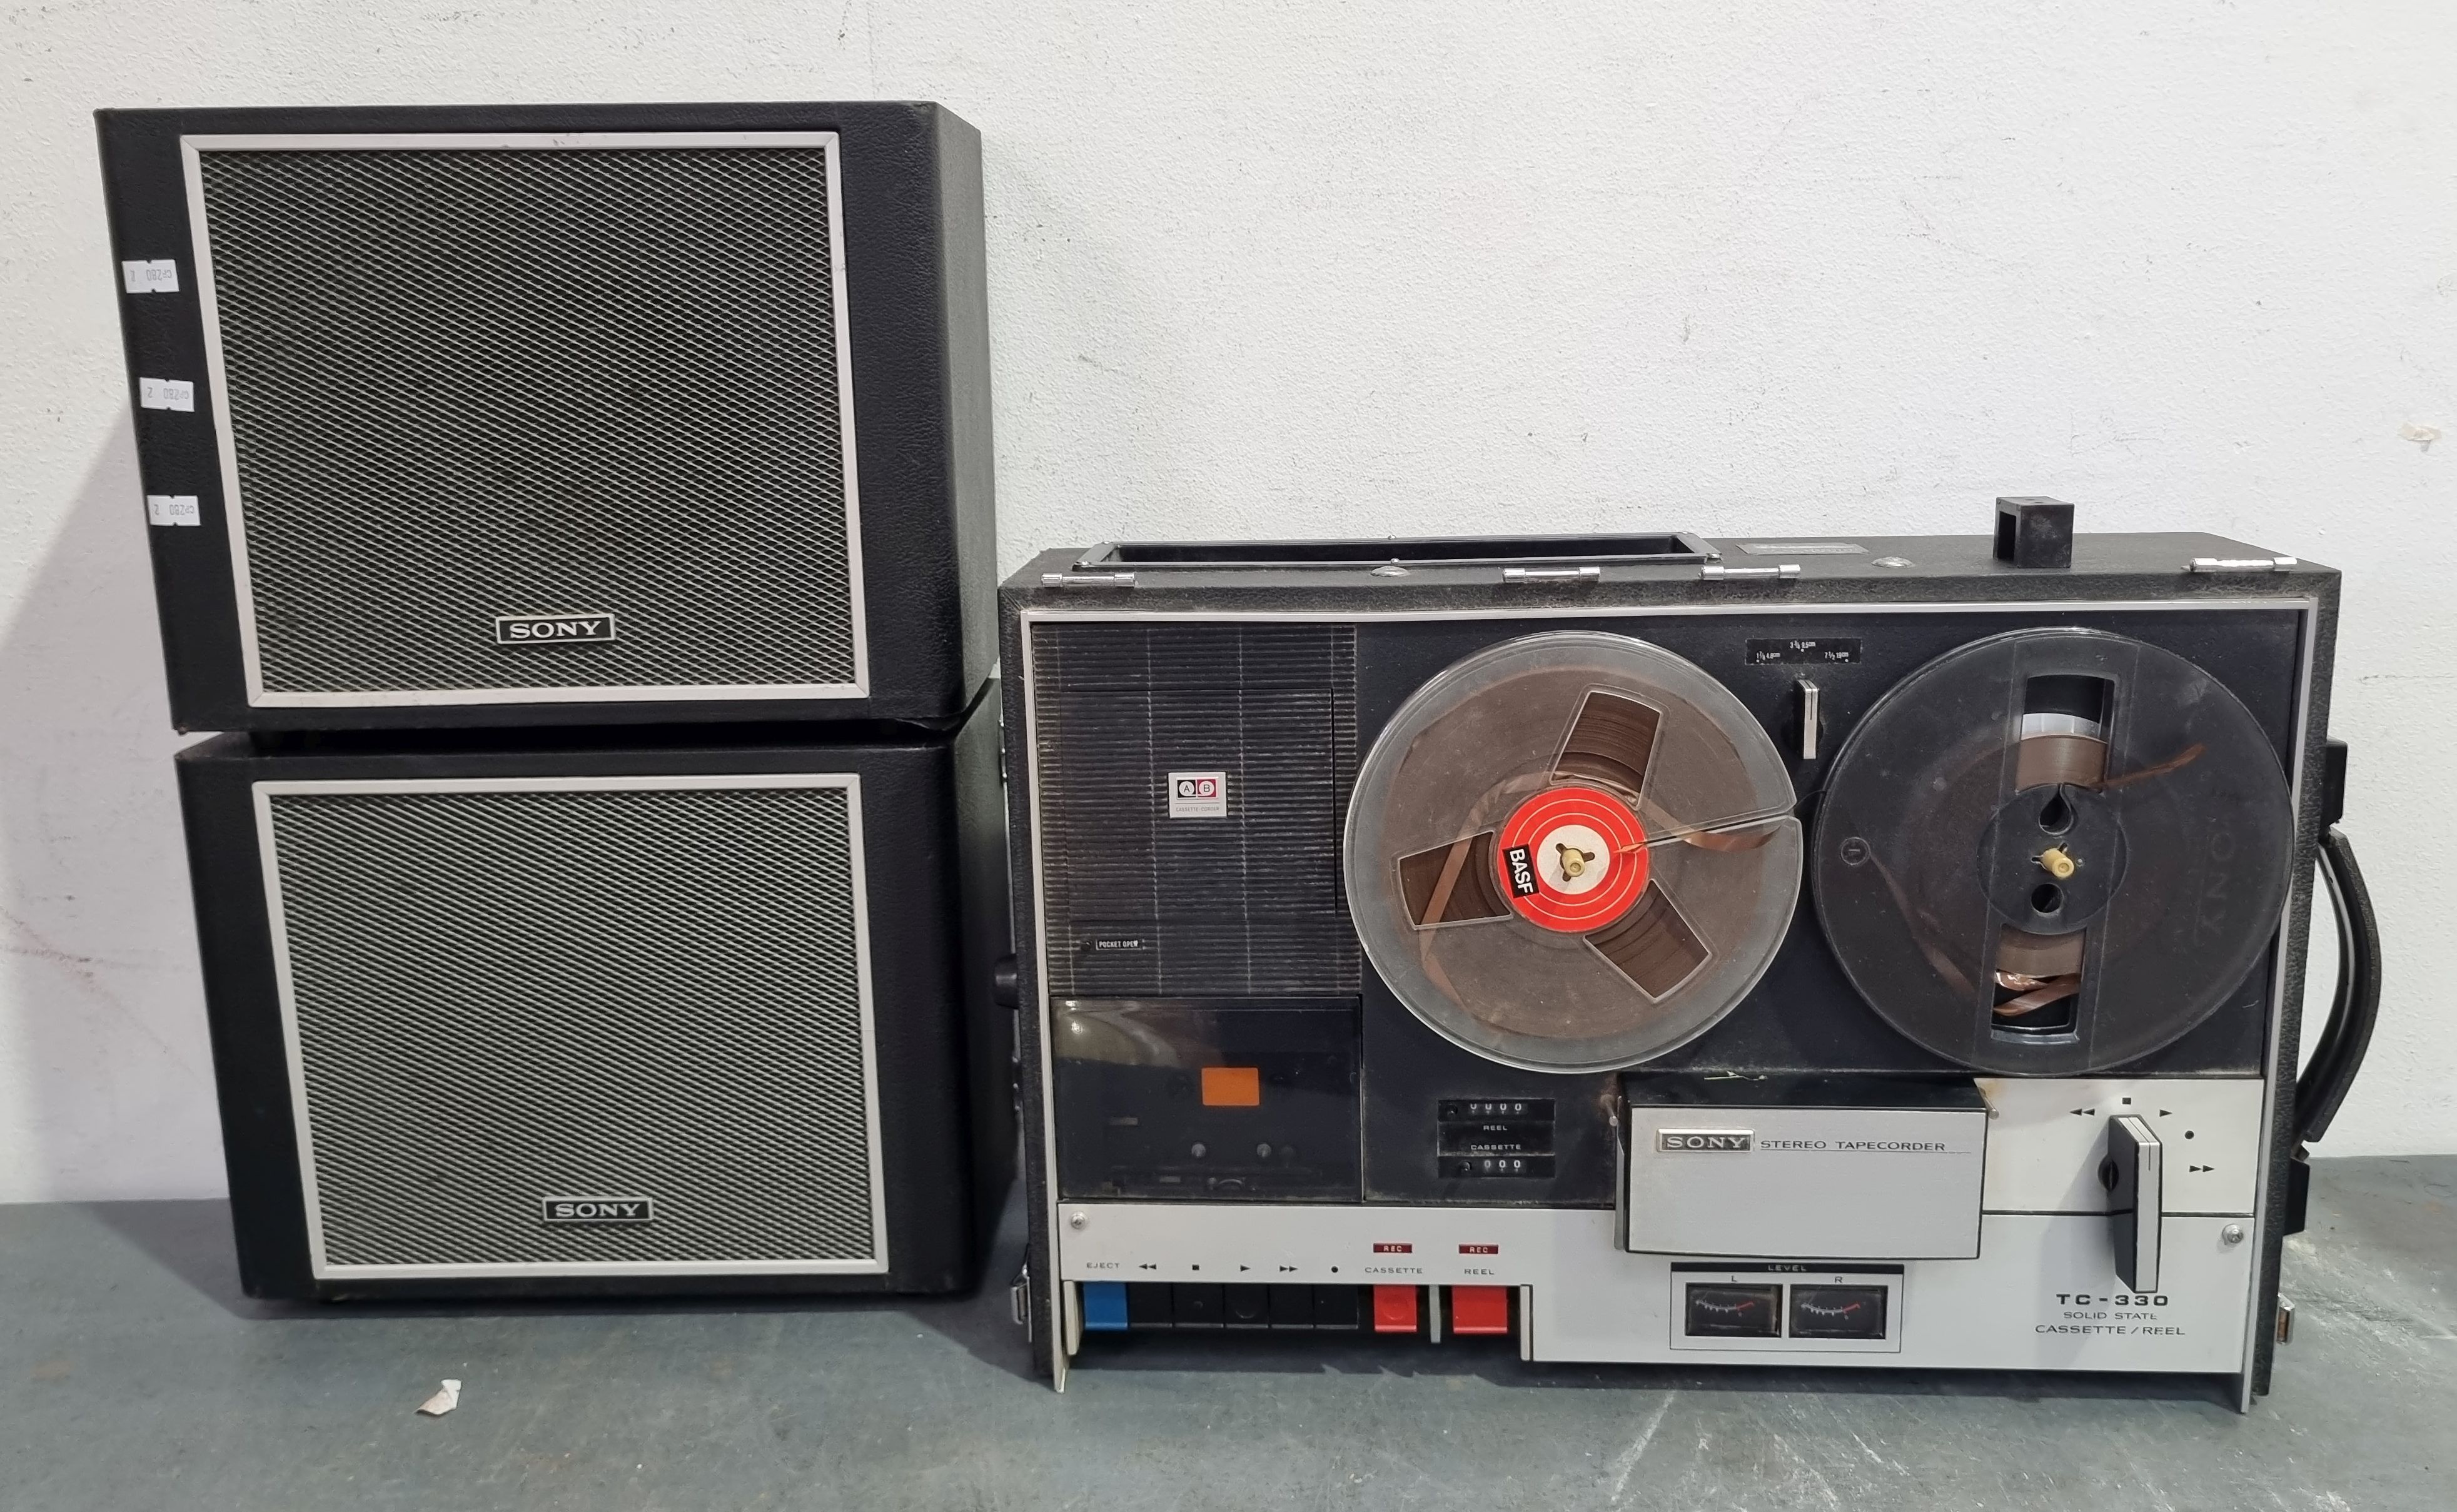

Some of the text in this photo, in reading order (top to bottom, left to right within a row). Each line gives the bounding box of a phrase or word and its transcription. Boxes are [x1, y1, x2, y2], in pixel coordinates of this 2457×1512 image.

[147, 386, 153, 398] 2
[154, 503, 159, 516] 2
[509, 620, 602, 639] SONY
[1184, 784, 1211, 793] A B
[1509, 849, 1534, 894] BASF
[1666, 1136, 1747, 1149] SONY
[1760, 1140, 1946, 1151] STEREO TAPECORDER
[1484, 1159, 1521, 1169] 000
[555, 1202, 641, 1218] SONY
[1834, 1276, 1844, 1284] R
[2056, 1294, 2169, 1306] TC-330
[2064, 1311, 2107, 1319] SOLID
